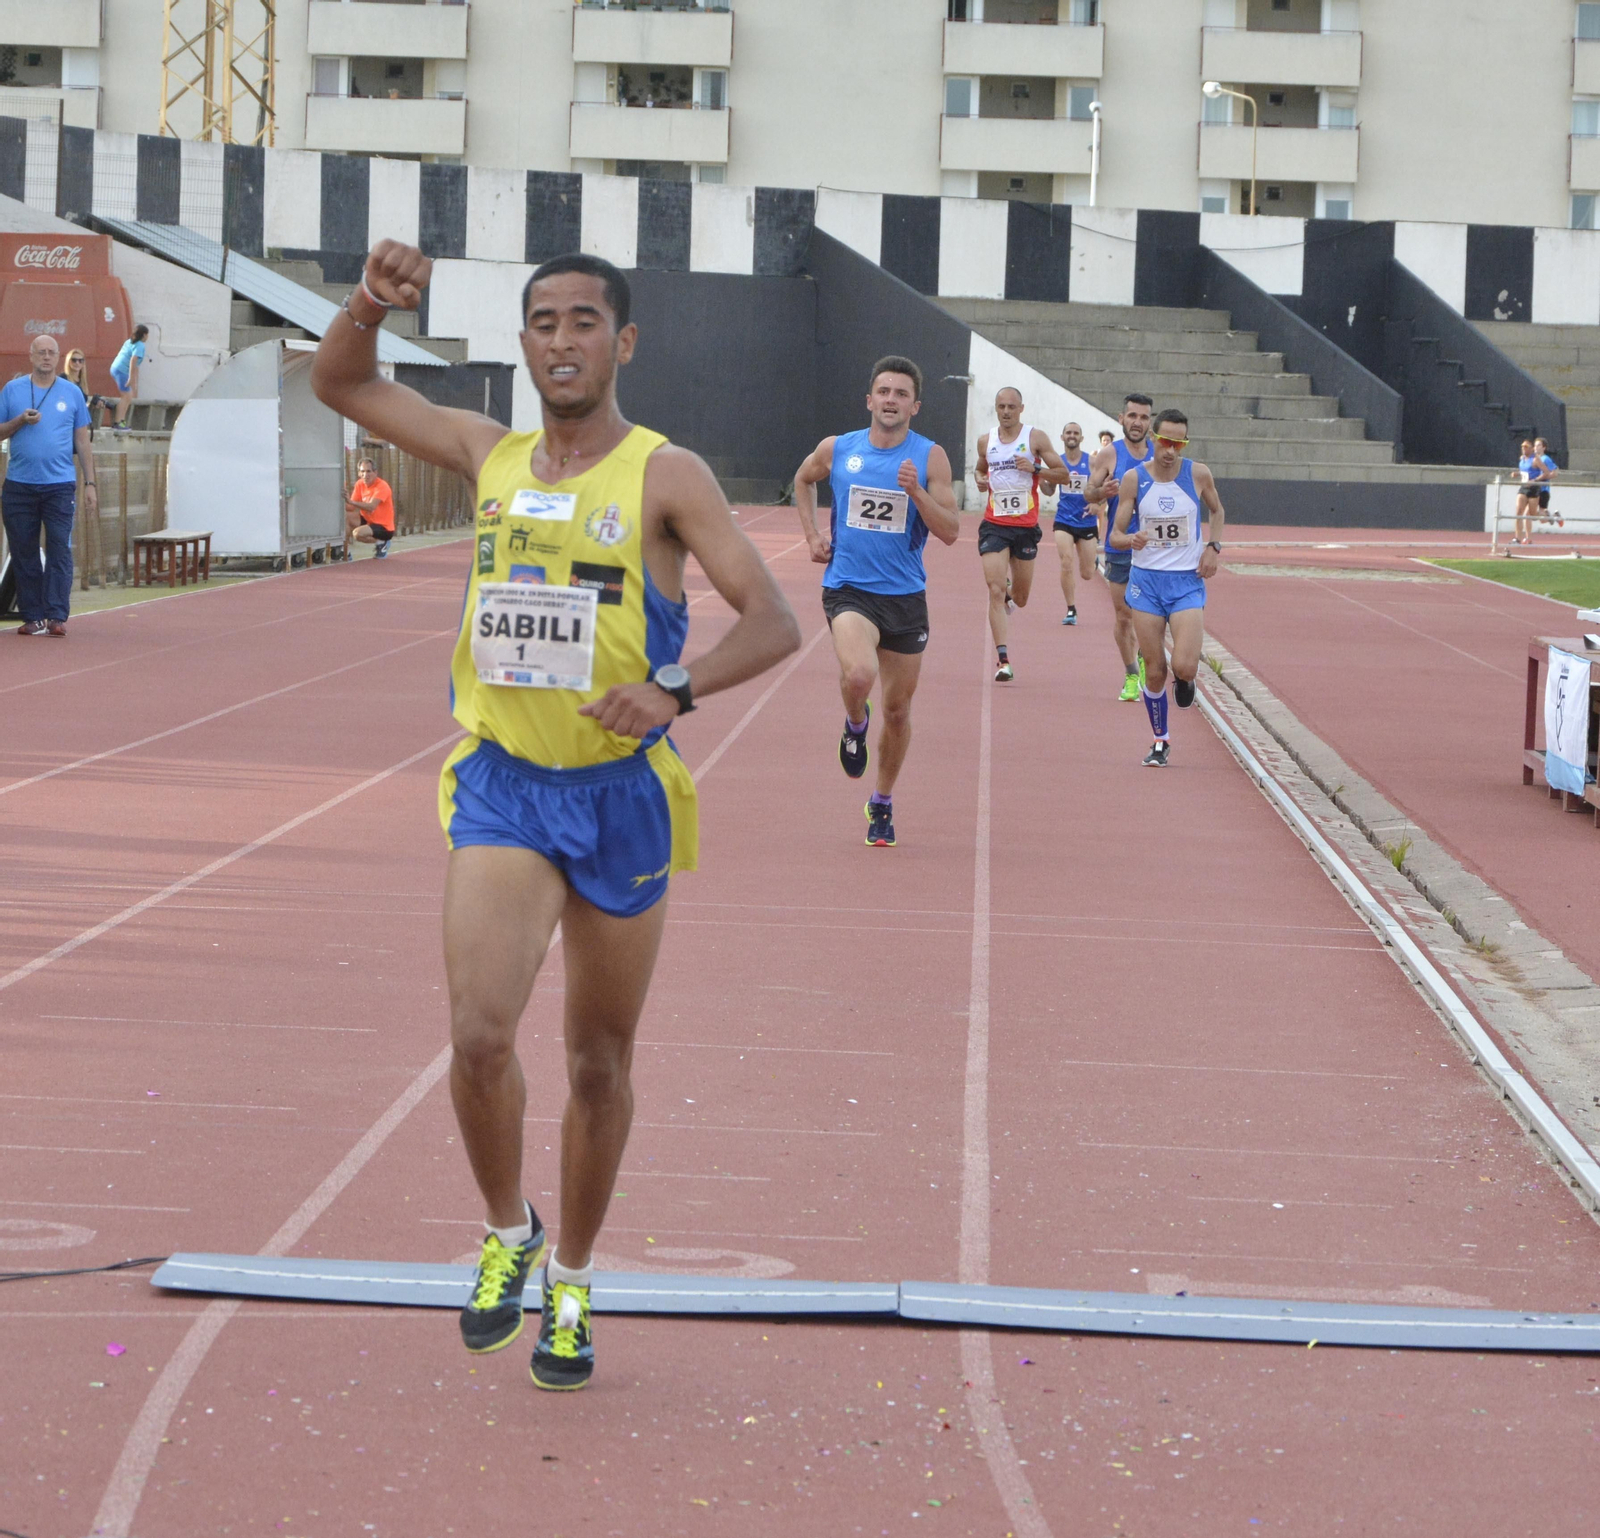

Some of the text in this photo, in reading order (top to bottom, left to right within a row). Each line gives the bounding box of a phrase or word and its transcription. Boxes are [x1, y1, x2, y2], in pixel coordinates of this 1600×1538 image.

[14, 245, 83, 269] Coca-Cola
[1068, 480, 1081, 489] 12
[519, 490, 572, 503] BROOKS
[1001, 496, 1020, 509] 16
[860, 499, 893, 521] 22
[1154, 523, 1179, 539] 18
[579, 579, 604, 590] QUIRO
[479, 611, 582, 643] SABILI
[515, 644, 526, 661] 1
